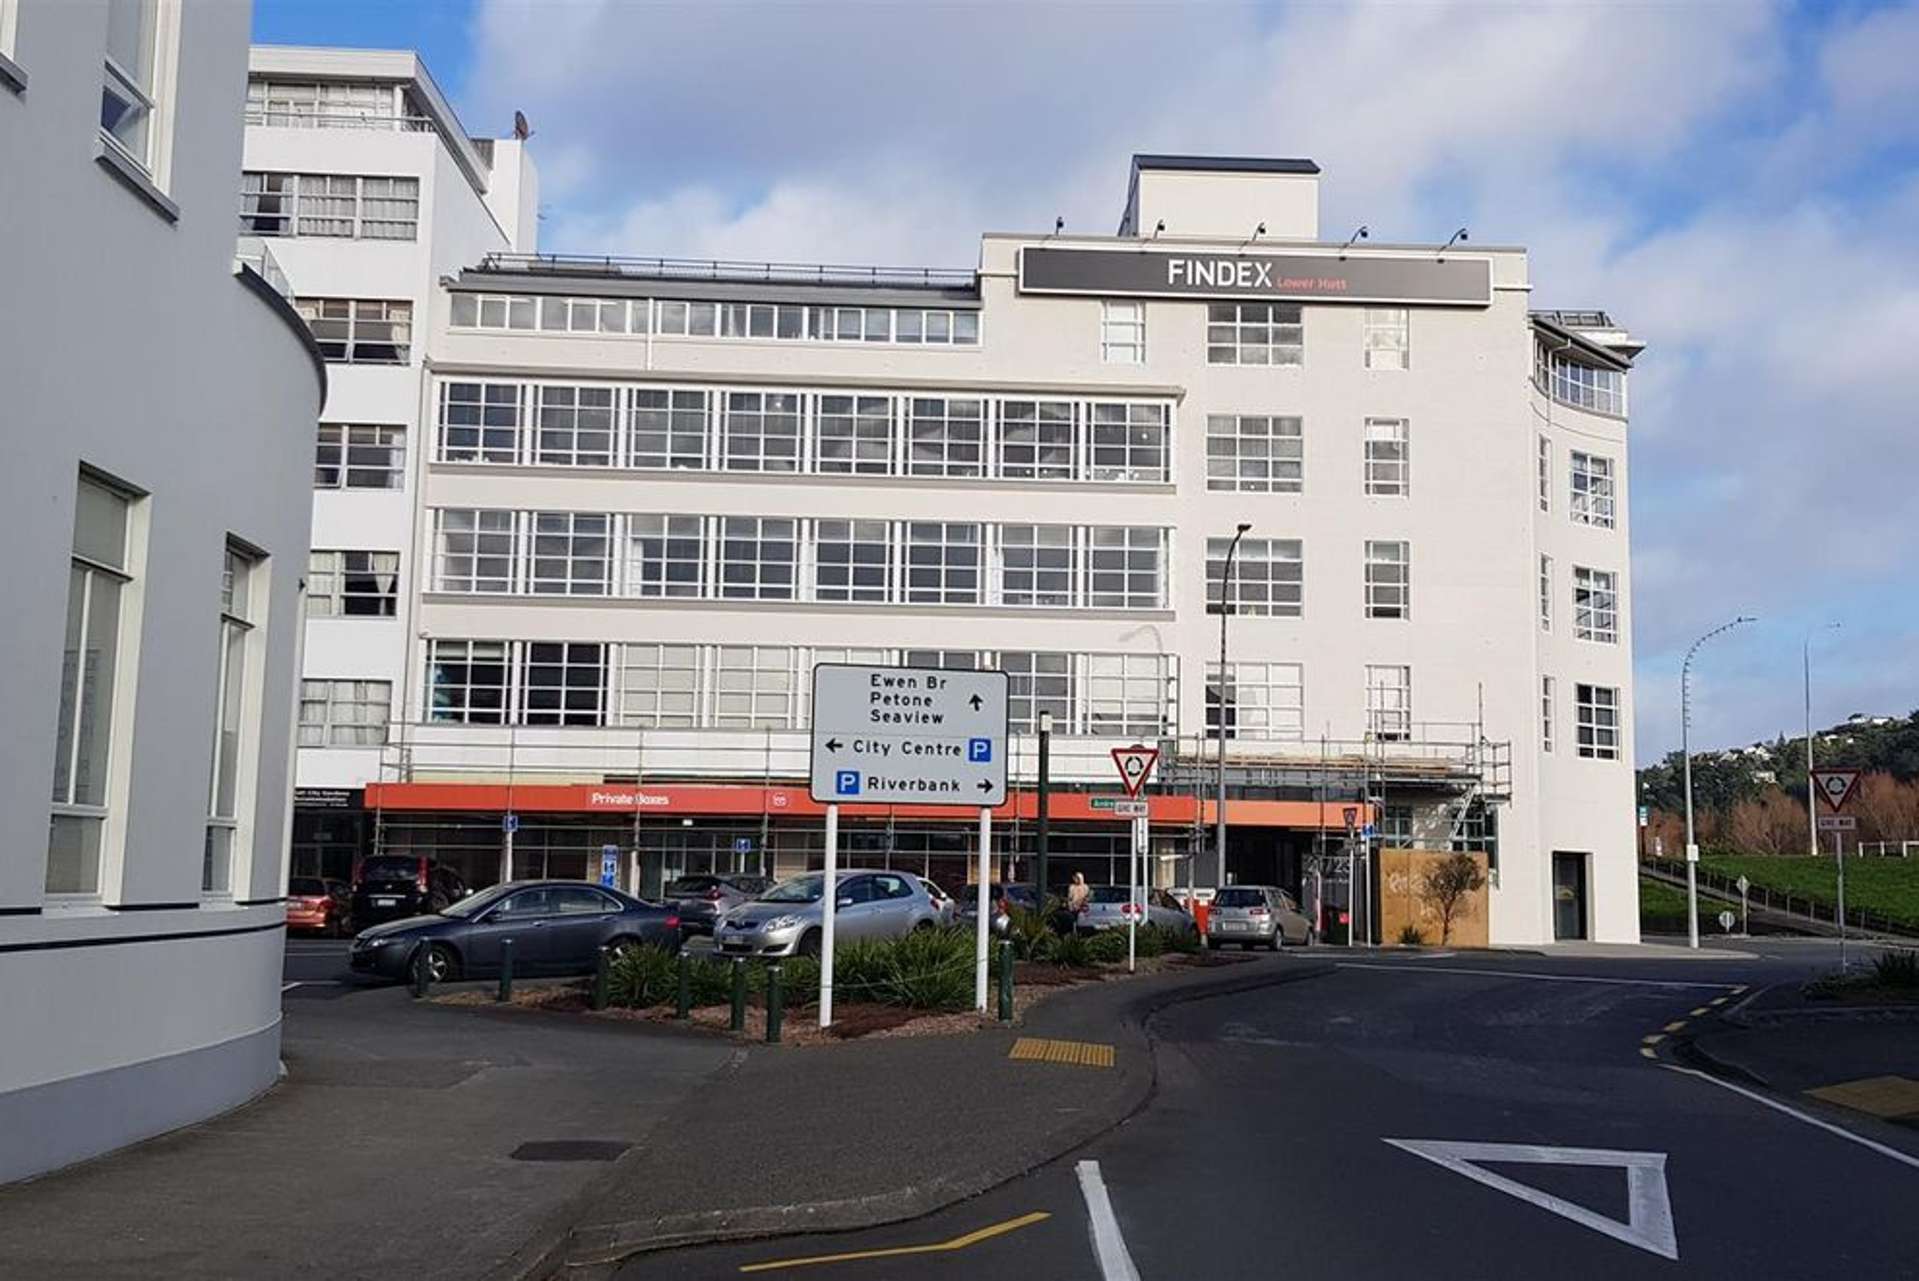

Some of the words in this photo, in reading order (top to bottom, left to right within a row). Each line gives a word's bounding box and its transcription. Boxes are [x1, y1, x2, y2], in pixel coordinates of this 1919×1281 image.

[1168, 259, 1273, 288] FINDEX
[1277, 277, 1313, 290] Lower
[1317, 277, 1347, 290] Hutt
[870, 673, 917, 689] Ewen
[926, 675, 947, 690] Br
[870, 692, 933, 707] Petone
[870, 709, 944, 724] Seaview
[853, 740, 891, 756] City
[902, 742, 962, 757] Centre
[973, 741, 988, 758] P
[840, 774, 856, 791] P
[867, 776, 961, 792] Riverbank
[592, 792, 633, 805] Private
[635, 792, 670, 805] Boxes
